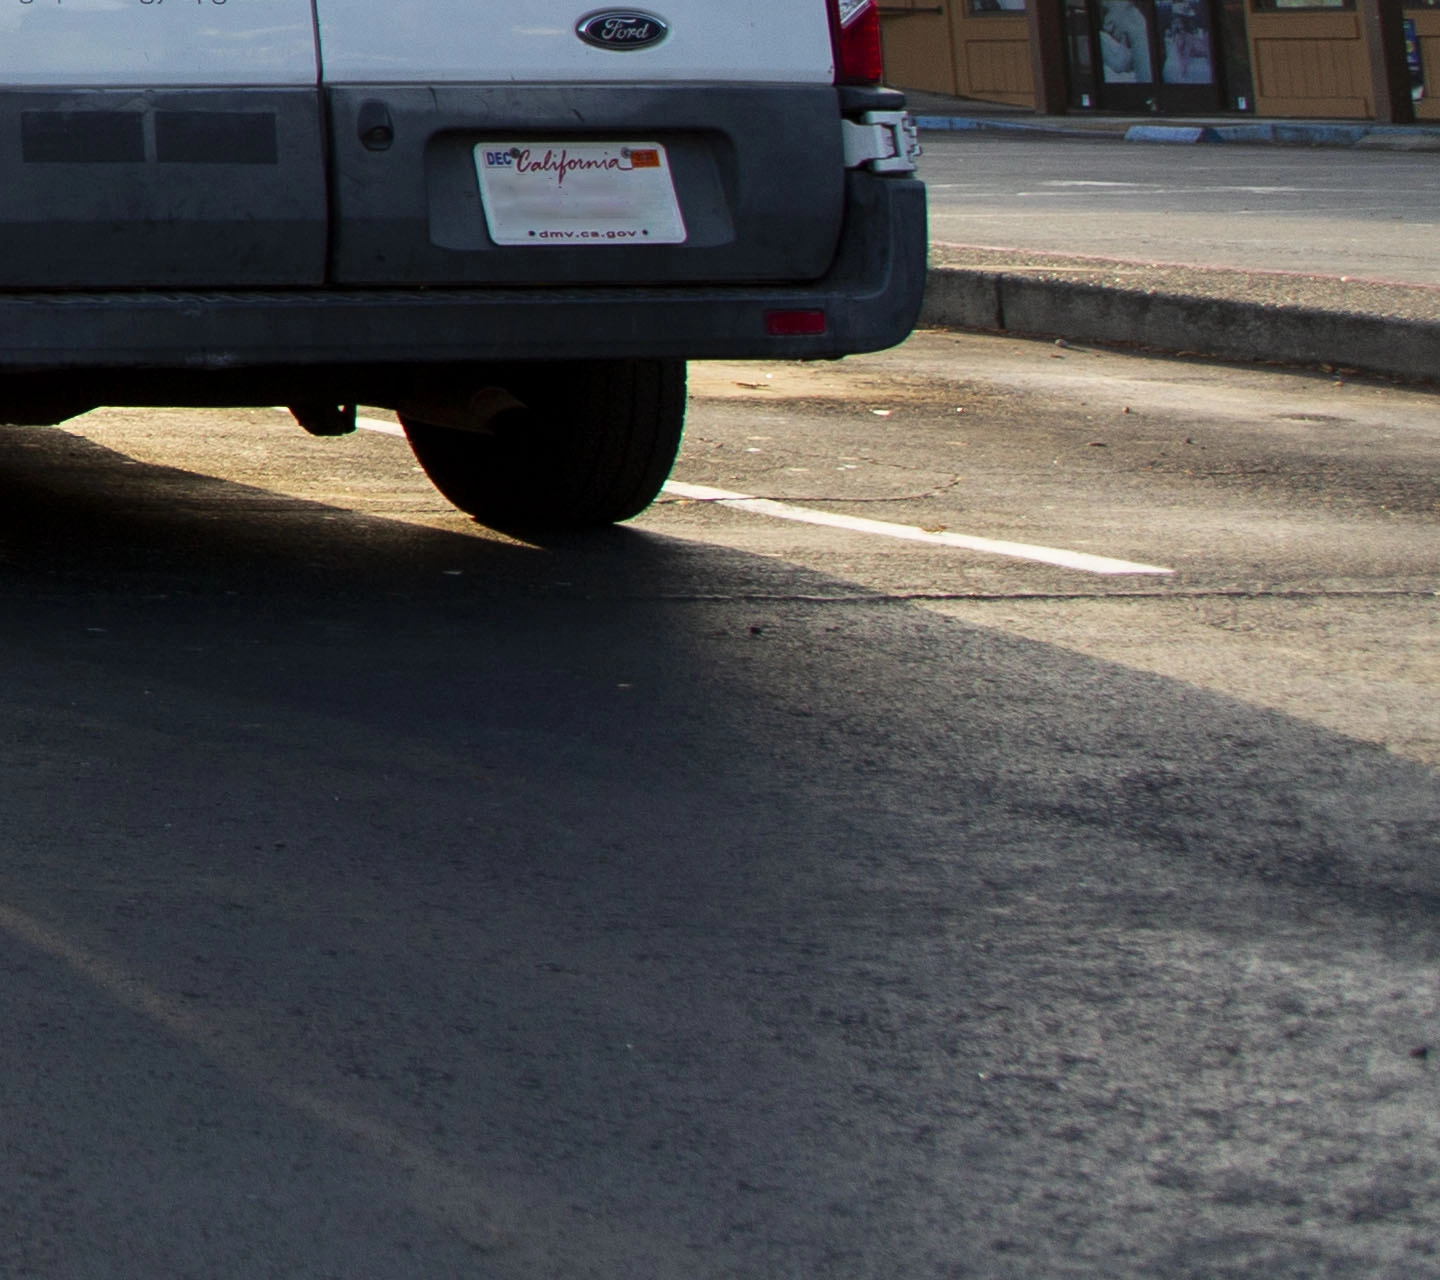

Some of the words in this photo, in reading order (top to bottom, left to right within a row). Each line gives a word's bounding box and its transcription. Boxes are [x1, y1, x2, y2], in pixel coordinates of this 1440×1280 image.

[600, 17, 651, 42] Ford
[486, 151, 513, 166] DEC
[516, 148, 634, 184] California
[538, 229, 638, 240] dmv.ca.gov
